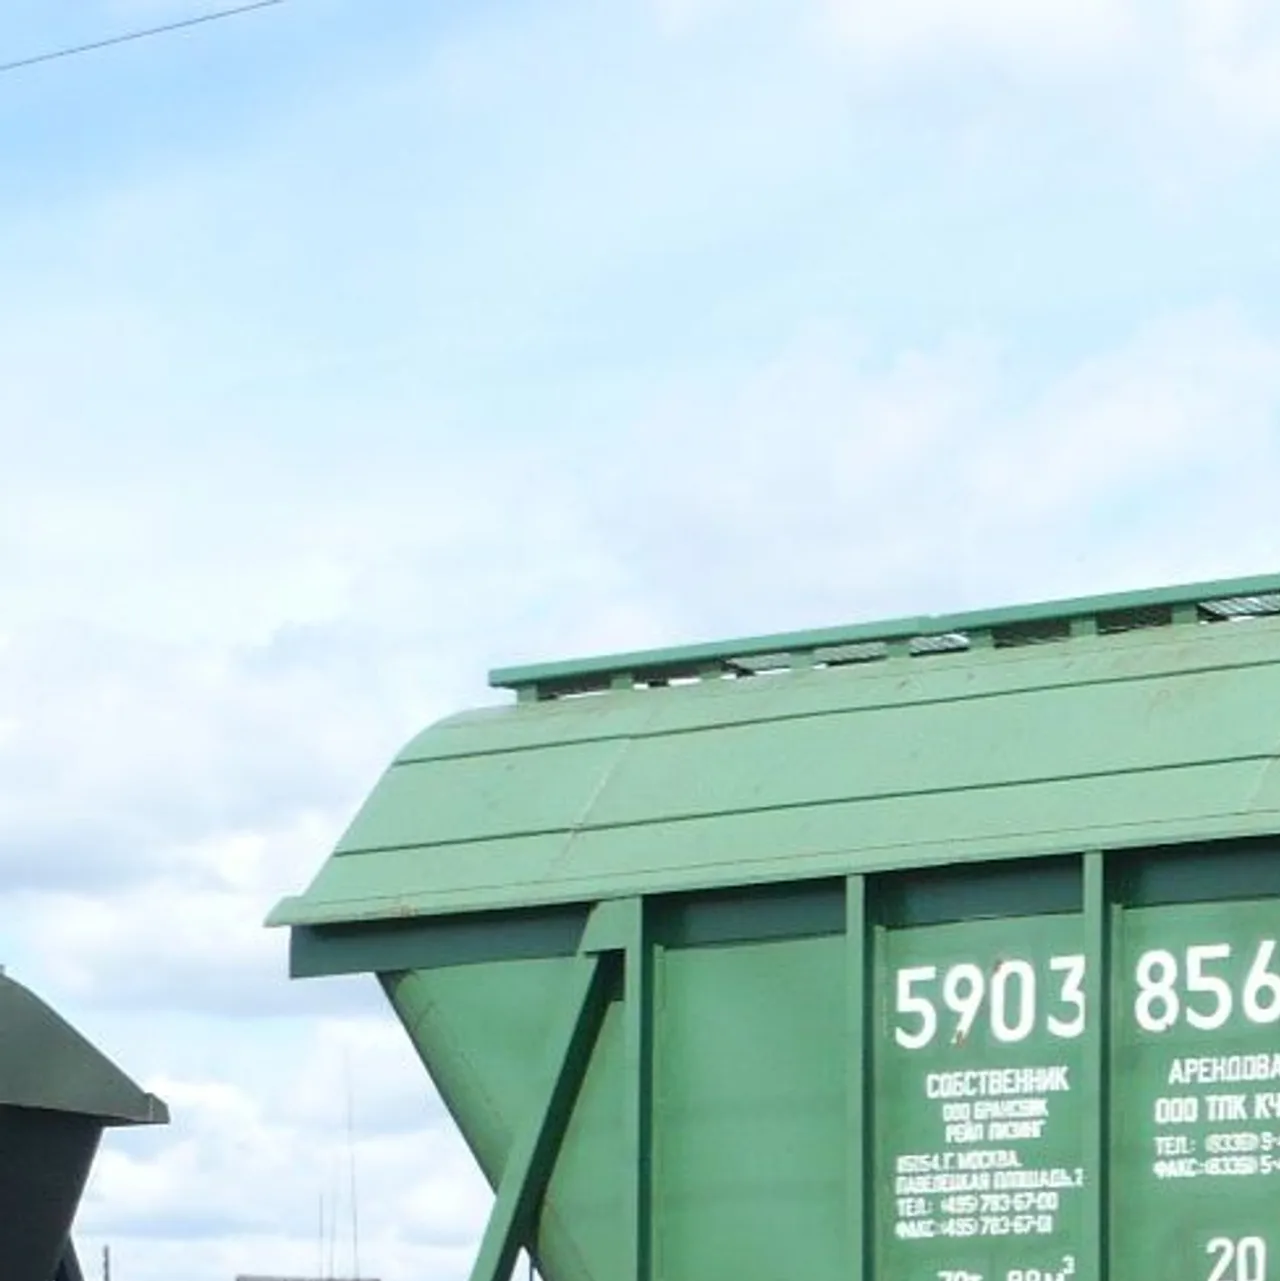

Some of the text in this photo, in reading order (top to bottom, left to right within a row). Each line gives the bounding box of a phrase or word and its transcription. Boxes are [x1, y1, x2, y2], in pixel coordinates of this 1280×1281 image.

[894, 953, 1086, 1050] 5903
[926, 1066, 1070, 1099] СОБСТВЕННИК
[1154, 1096, 1198, 1124] ООО
[1205, 1094, 1248, 1121] ТПК
